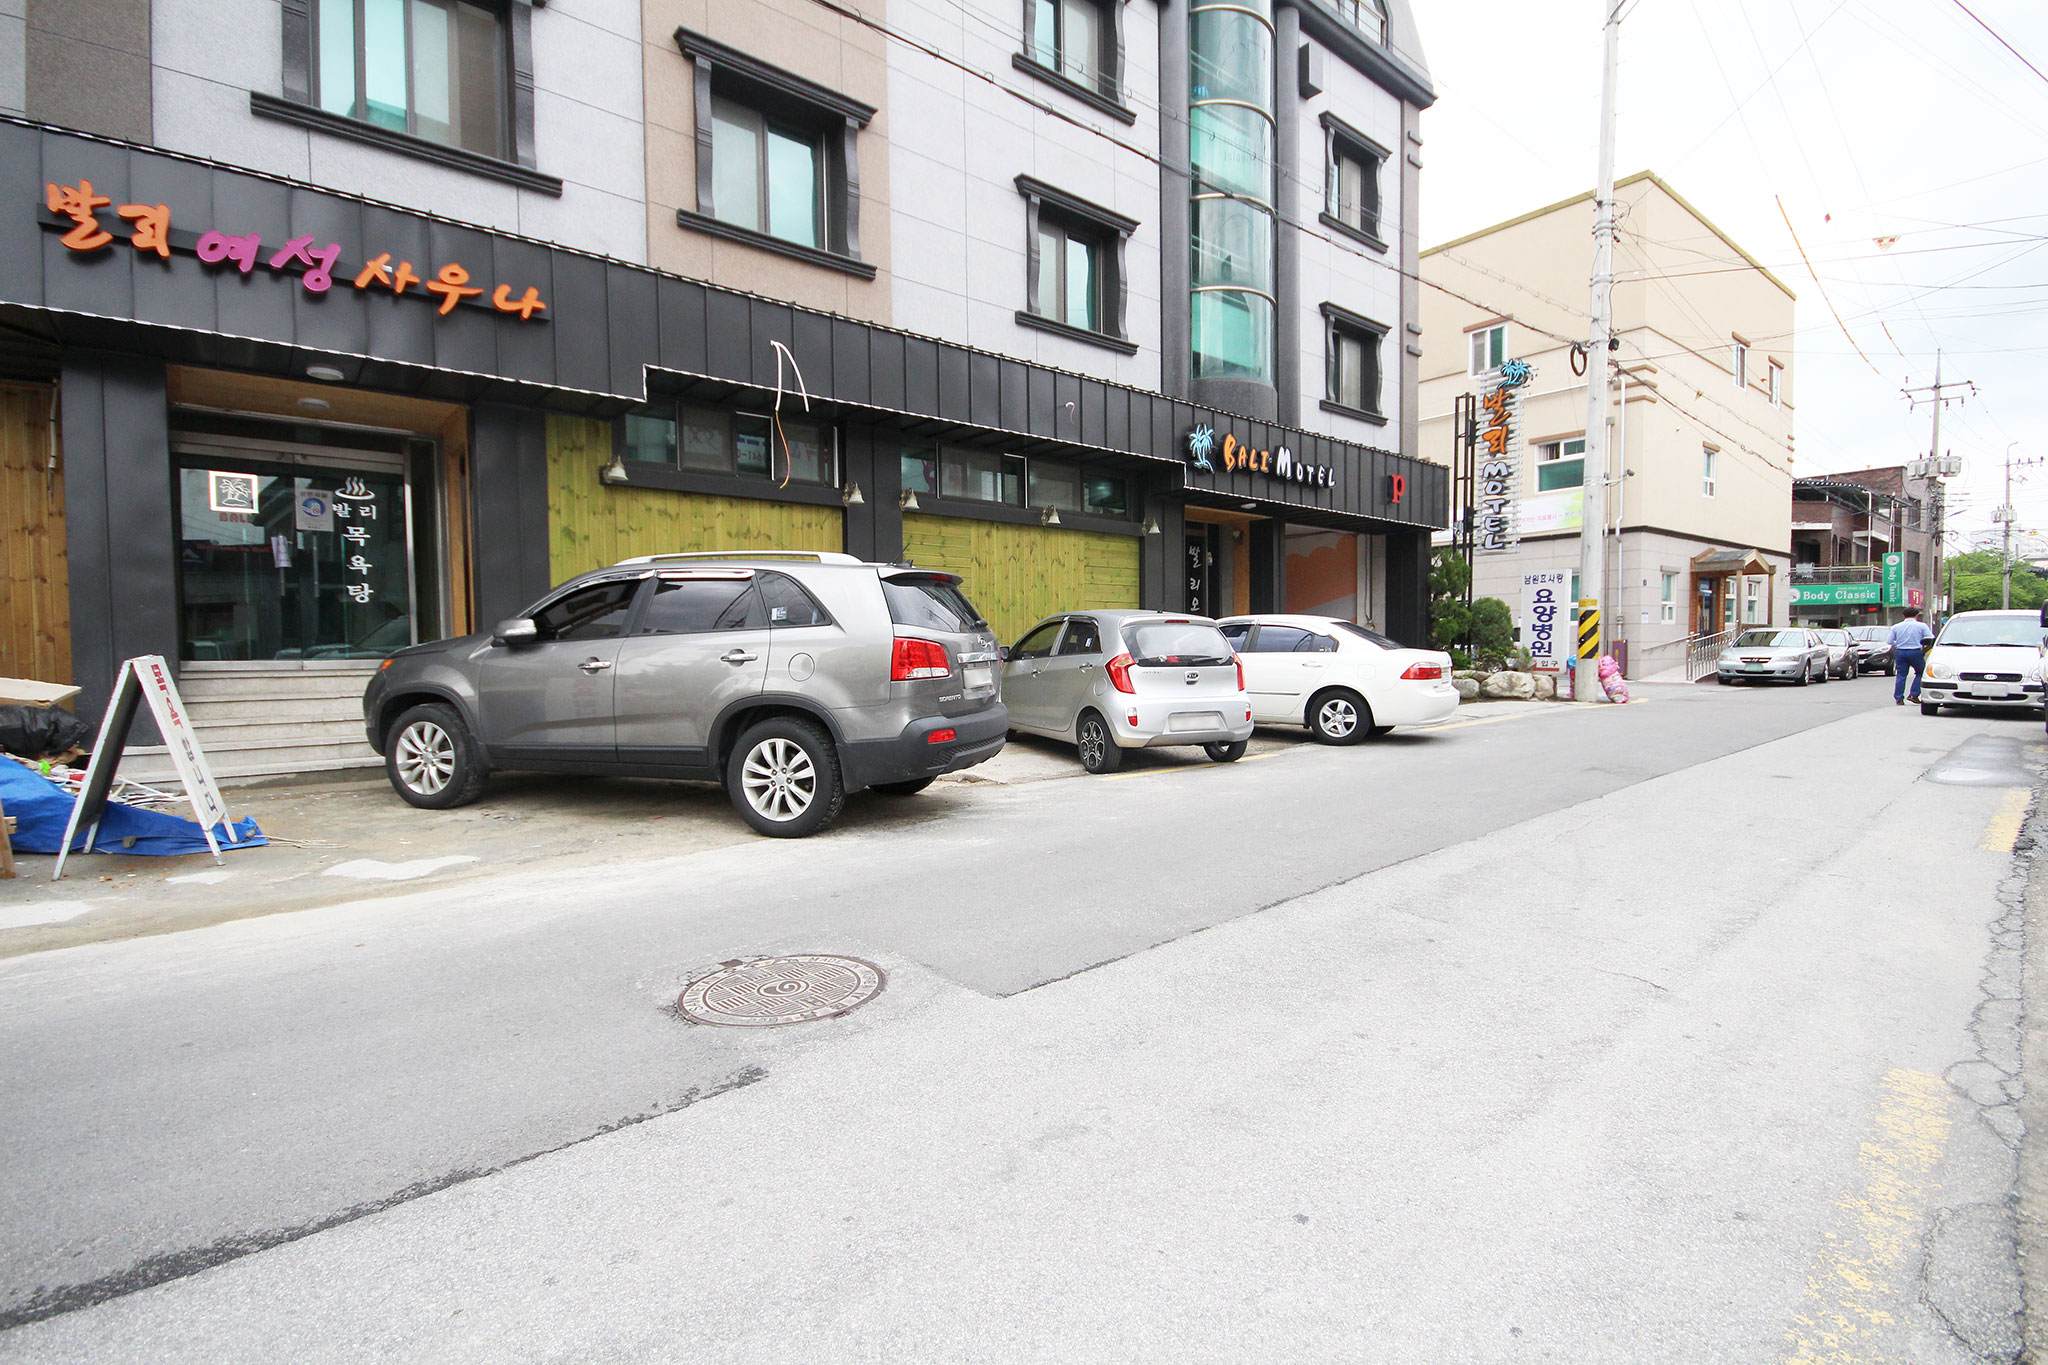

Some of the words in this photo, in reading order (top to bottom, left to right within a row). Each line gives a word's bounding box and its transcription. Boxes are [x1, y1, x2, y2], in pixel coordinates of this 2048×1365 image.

[45, 179, 171, 259] 발리
[195, 229, 341, 294] 여성
[353, 252, 548, 321] 사우나
[1223, 434, 1269, 472] BALI
[1276, 446, 1337, 488] MOTEL
[332, 502, 376, 520] 발리
[1483, 462, 1508, 549] MOTEL
[342, 525, 374, 604] 목욕탕
[1524, 573, 1564, 585] 남원효사랑
[1530, 588, 1558, 658] 요양병원
[1803, 592, 1830, 602] Body
[1835, 590, 1876, 600] Classic
[1541, 660, 1558, 668] 입구
